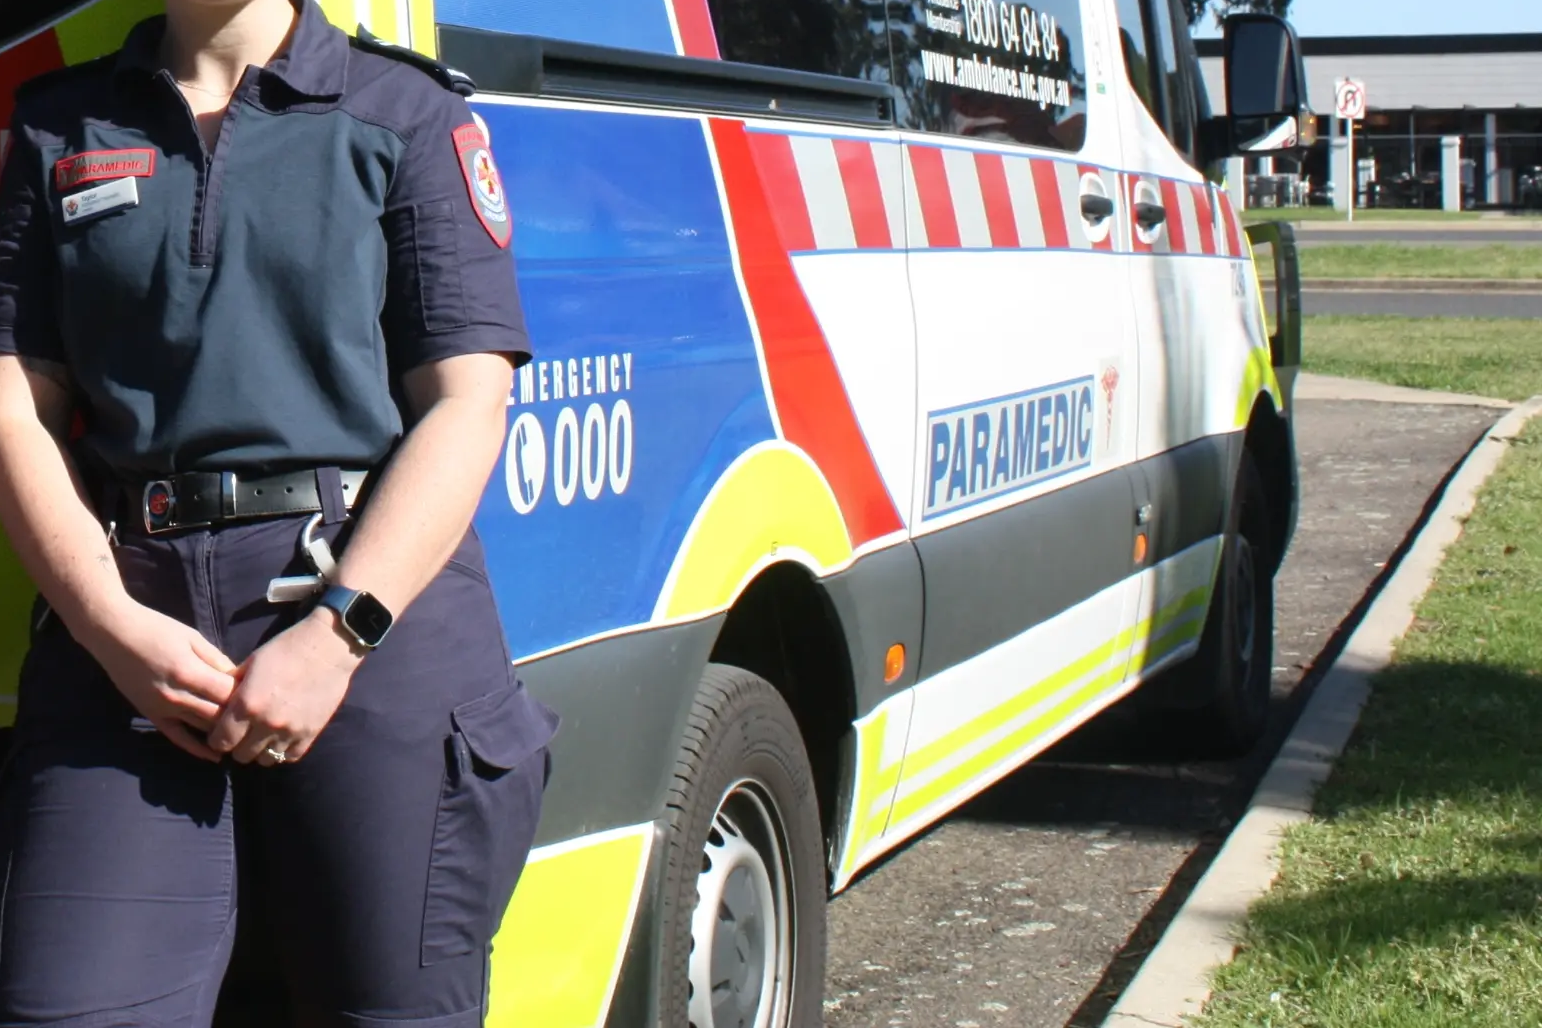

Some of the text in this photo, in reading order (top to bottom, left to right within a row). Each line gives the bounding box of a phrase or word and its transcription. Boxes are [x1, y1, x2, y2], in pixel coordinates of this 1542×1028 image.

[926, 8, 962, 38] Membership
[1000, 0, 1020, 53] 64
[1020, 7, 1040, 57] 84
[1040, 12, 1059, 62] 84
[921, 49, 1070, 111] www.ambulance.vic.gov.au
[554, 399, 633, 506] 000
[927, 386, 1092, 508] PARAMEDIC
